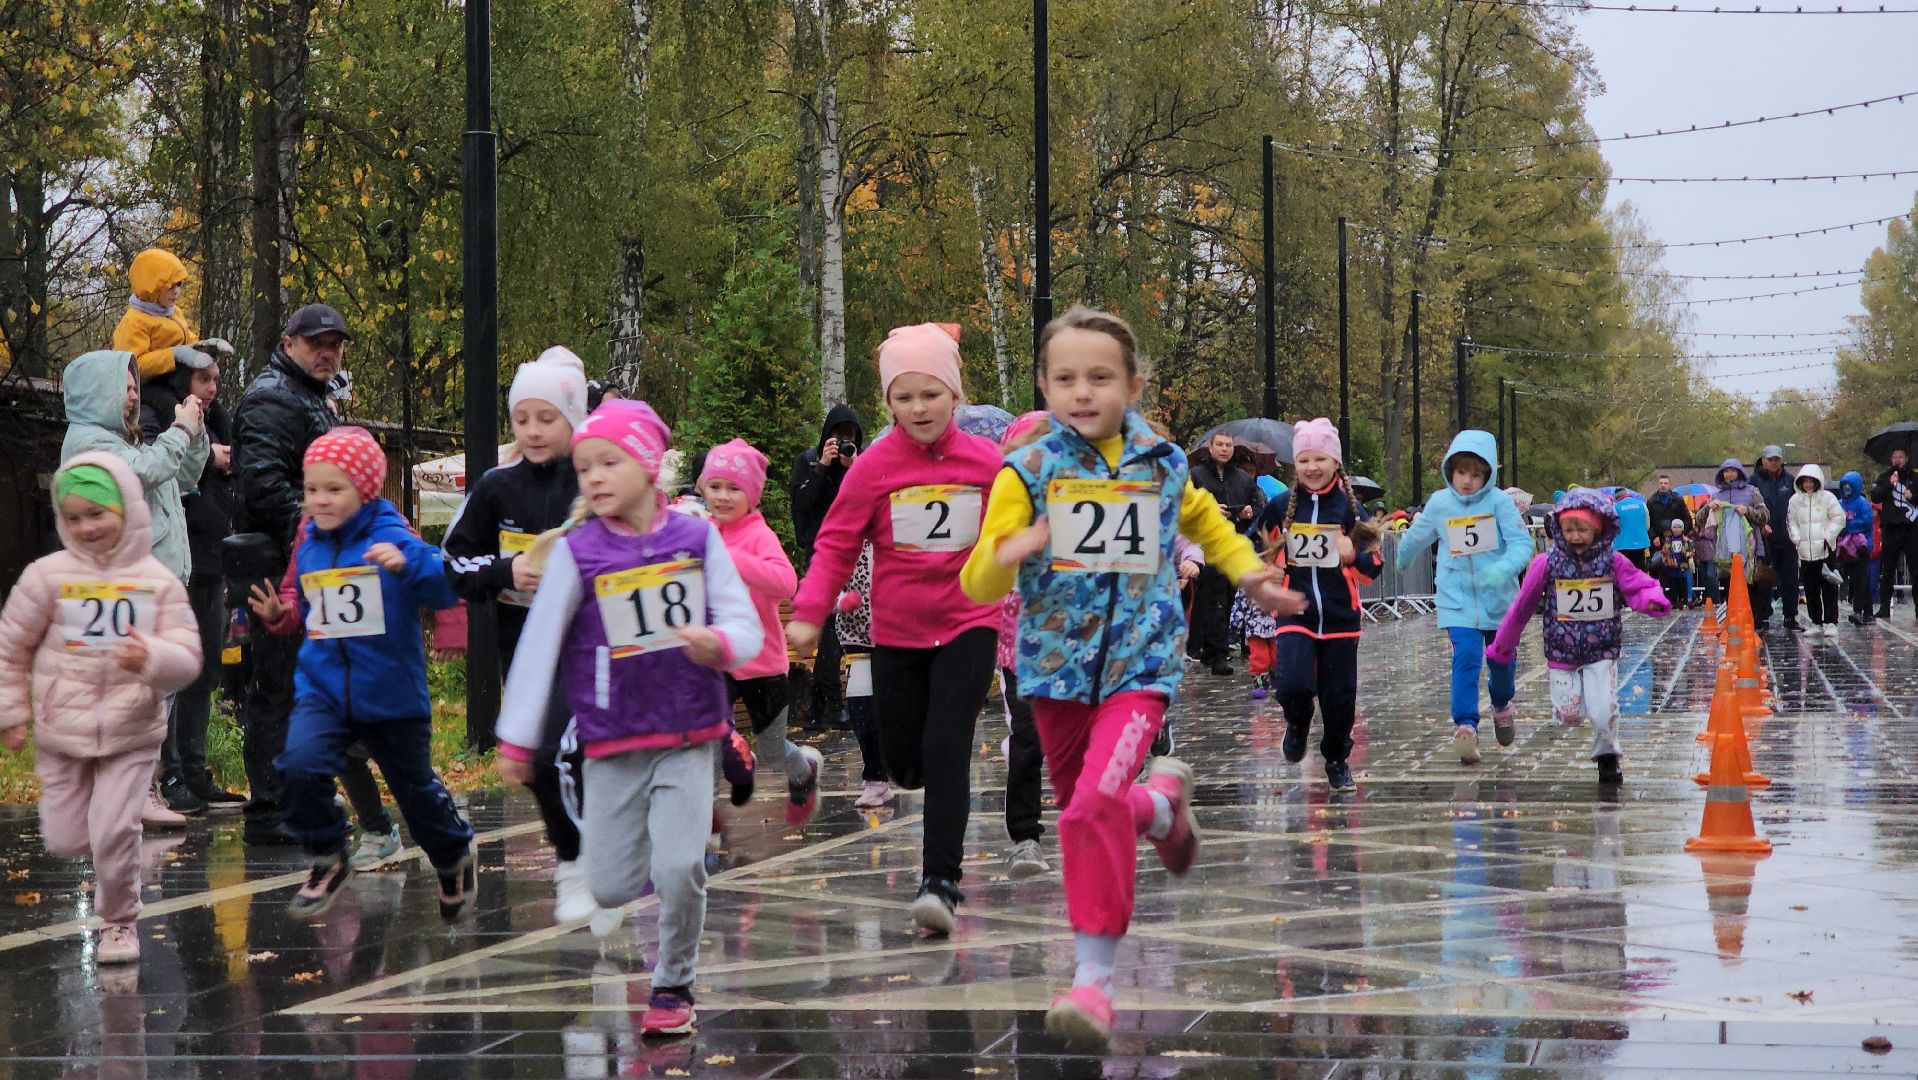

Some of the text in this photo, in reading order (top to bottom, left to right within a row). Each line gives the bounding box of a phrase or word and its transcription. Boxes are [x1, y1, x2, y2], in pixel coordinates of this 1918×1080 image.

[925, 500, 951, 539] 2
[1072, 500, 1144, 555] 24
[1465, 524, 1479, 547] 5
[1294, 533, 1329, 560] 23
[81, 597, 135, 637] 20
[321, 583, 364, 625] 13
[626, 581, 691, 638] 18
[1567, 587, 1603, 613] 25
